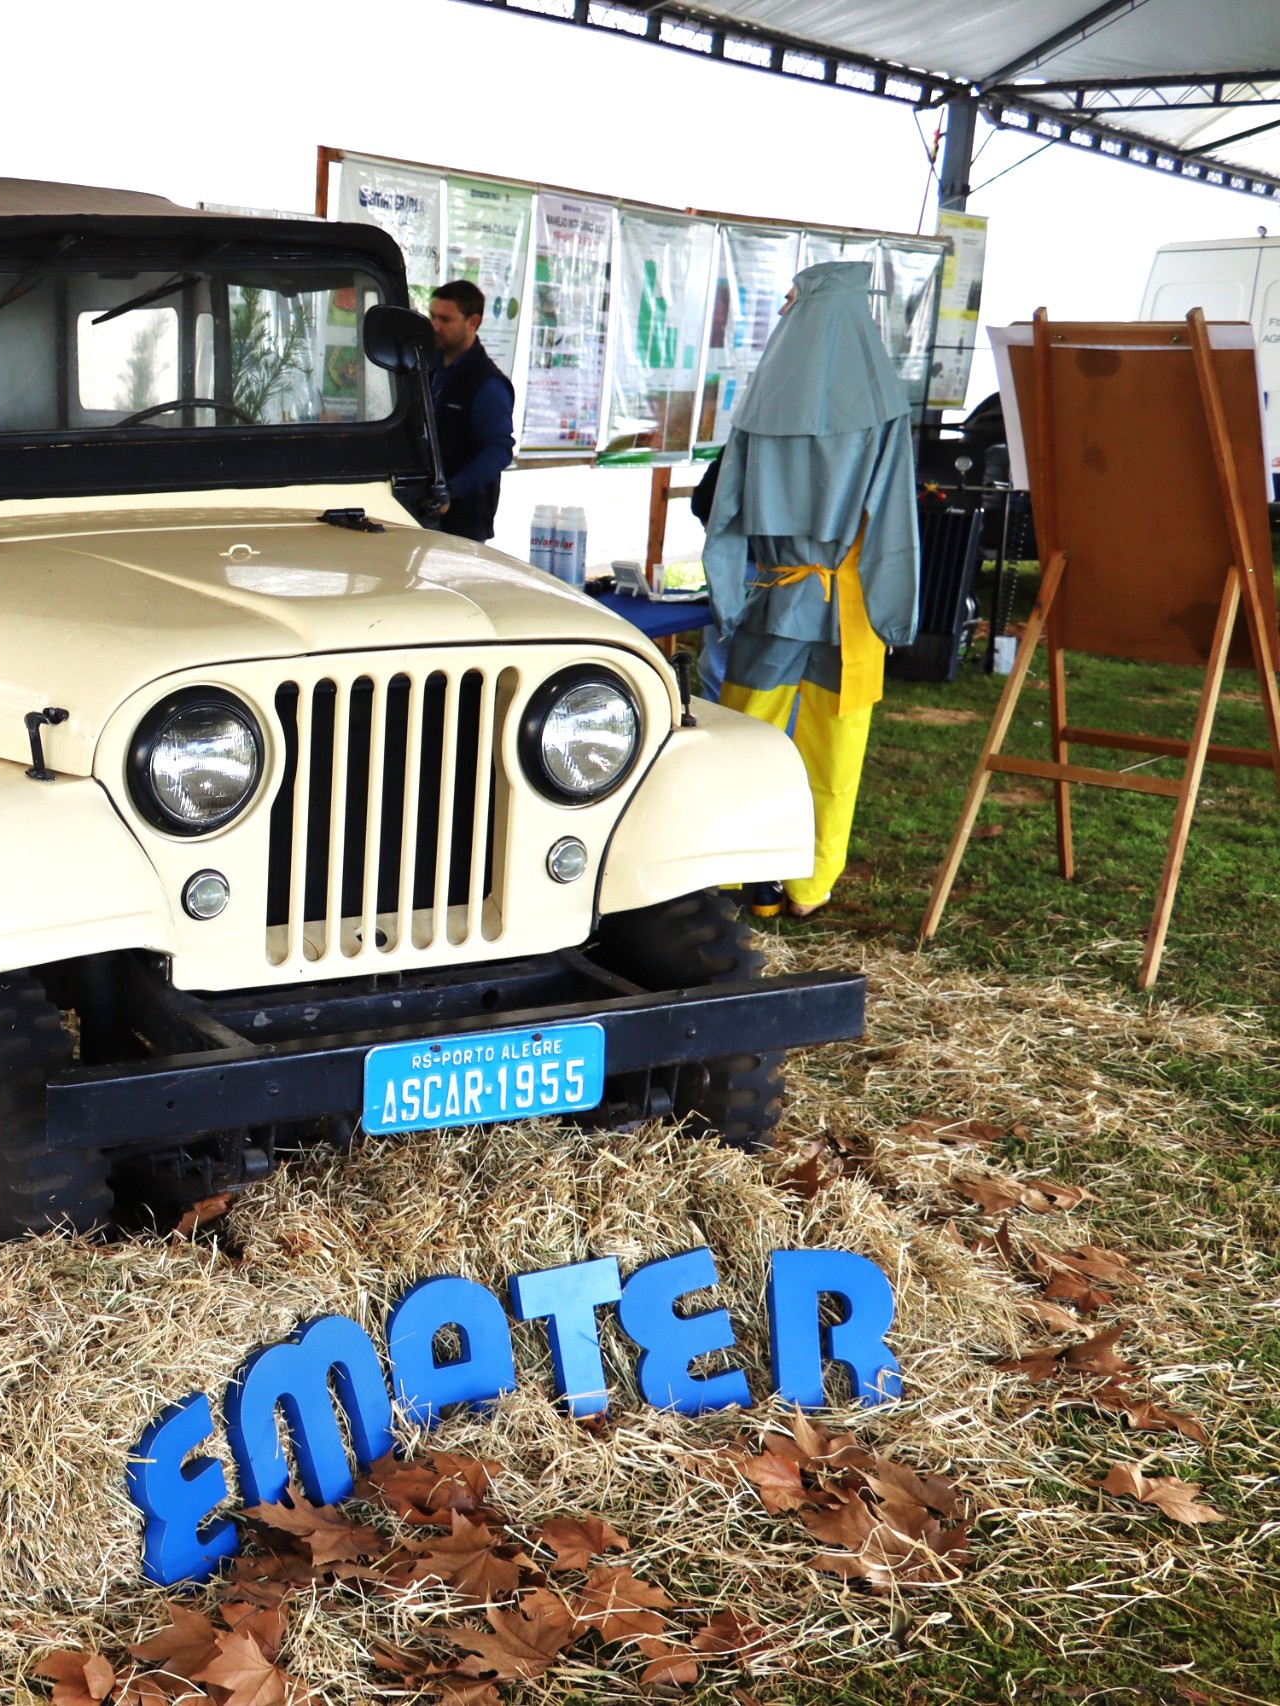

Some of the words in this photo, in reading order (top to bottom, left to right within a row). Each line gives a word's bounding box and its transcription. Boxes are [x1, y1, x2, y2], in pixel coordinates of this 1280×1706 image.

[412, 1048, 494, 1069] RS-PORTO
[501, 1039, 563, 1060] ALEGRE
[127, 1246, 903, 1587] EMATER
